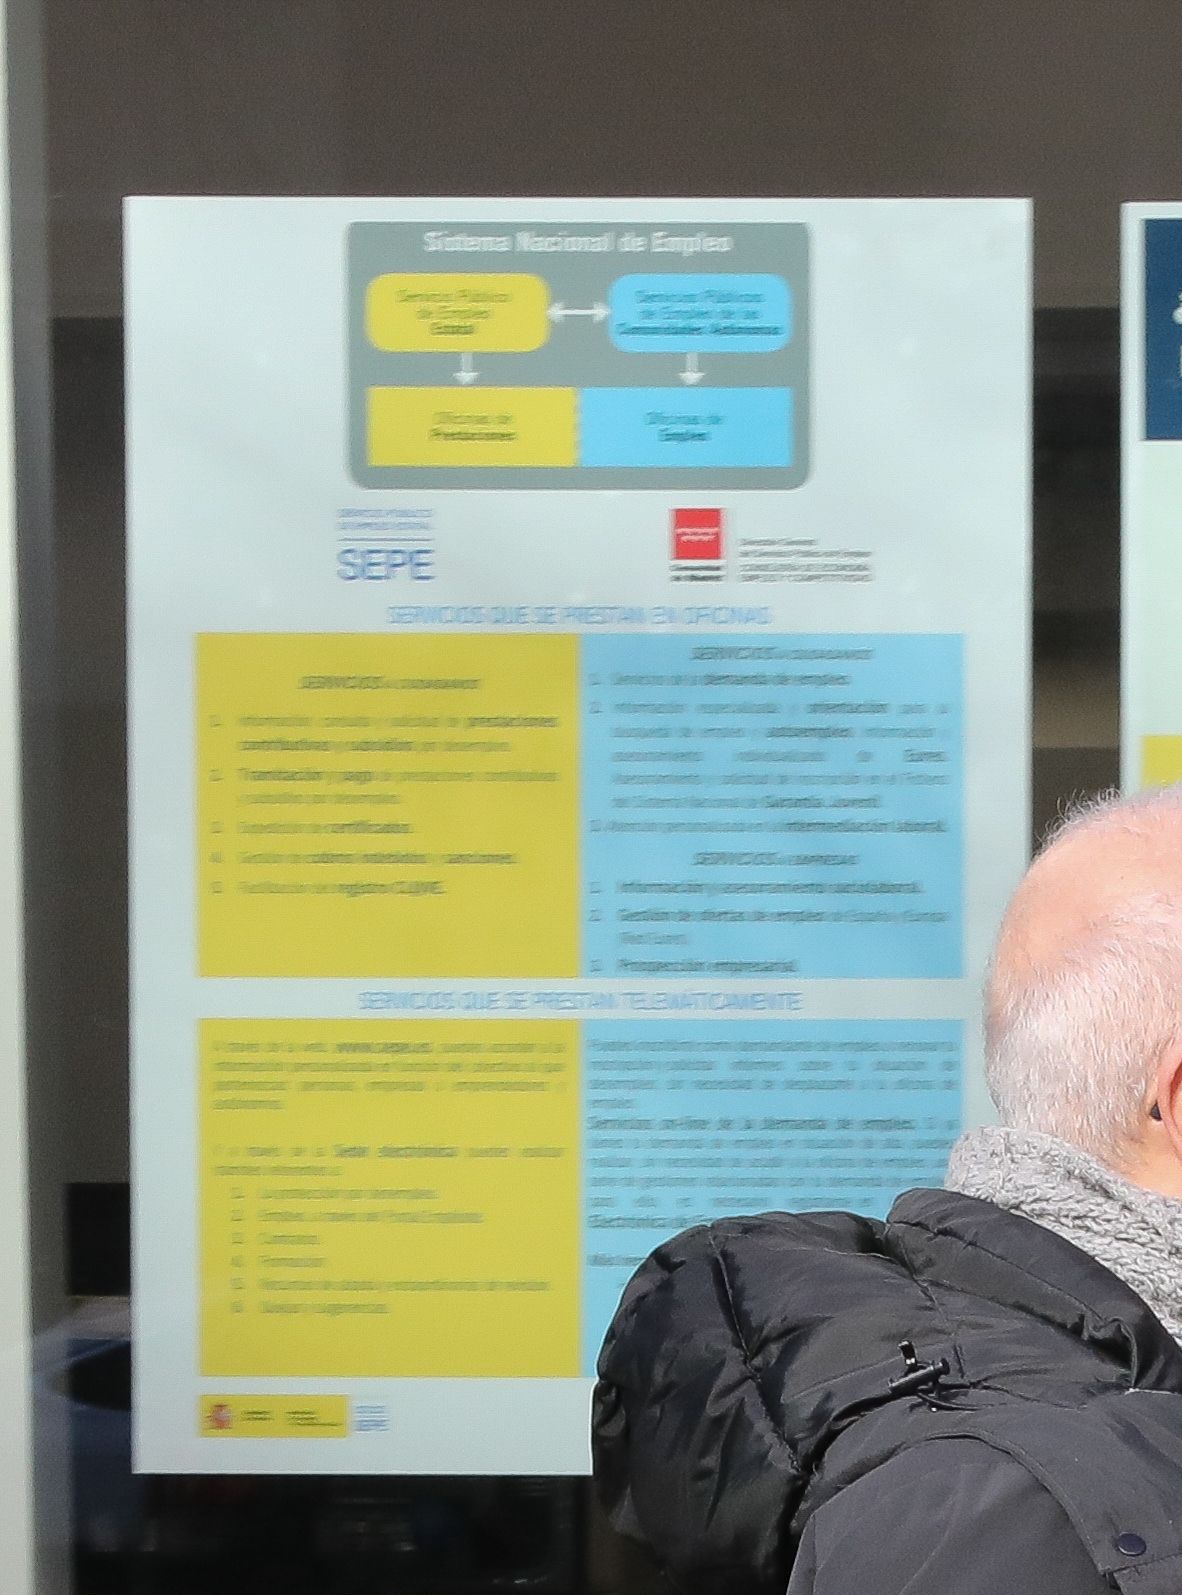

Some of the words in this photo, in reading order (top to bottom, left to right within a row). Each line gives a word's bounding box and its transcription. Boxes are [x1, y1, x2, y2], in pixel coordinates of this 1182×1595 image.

[423, 231, 513, 254] Sistema
[515, 231, 614, 254] Nacional
[619, 231, 646, 254] de
[650, 231, 733, 257] Empleo
[337, 548, 436, 580] SEPE
[359, 992, 454, 1010] SERVICIOS
[462, 992, 501, 1010] QUE
[506, 992, 529, 1010] SE
[533, 992, 617, 1010] PRESTAN
[622, 991, 803, 1010] TELEMÁTICAMENTE
